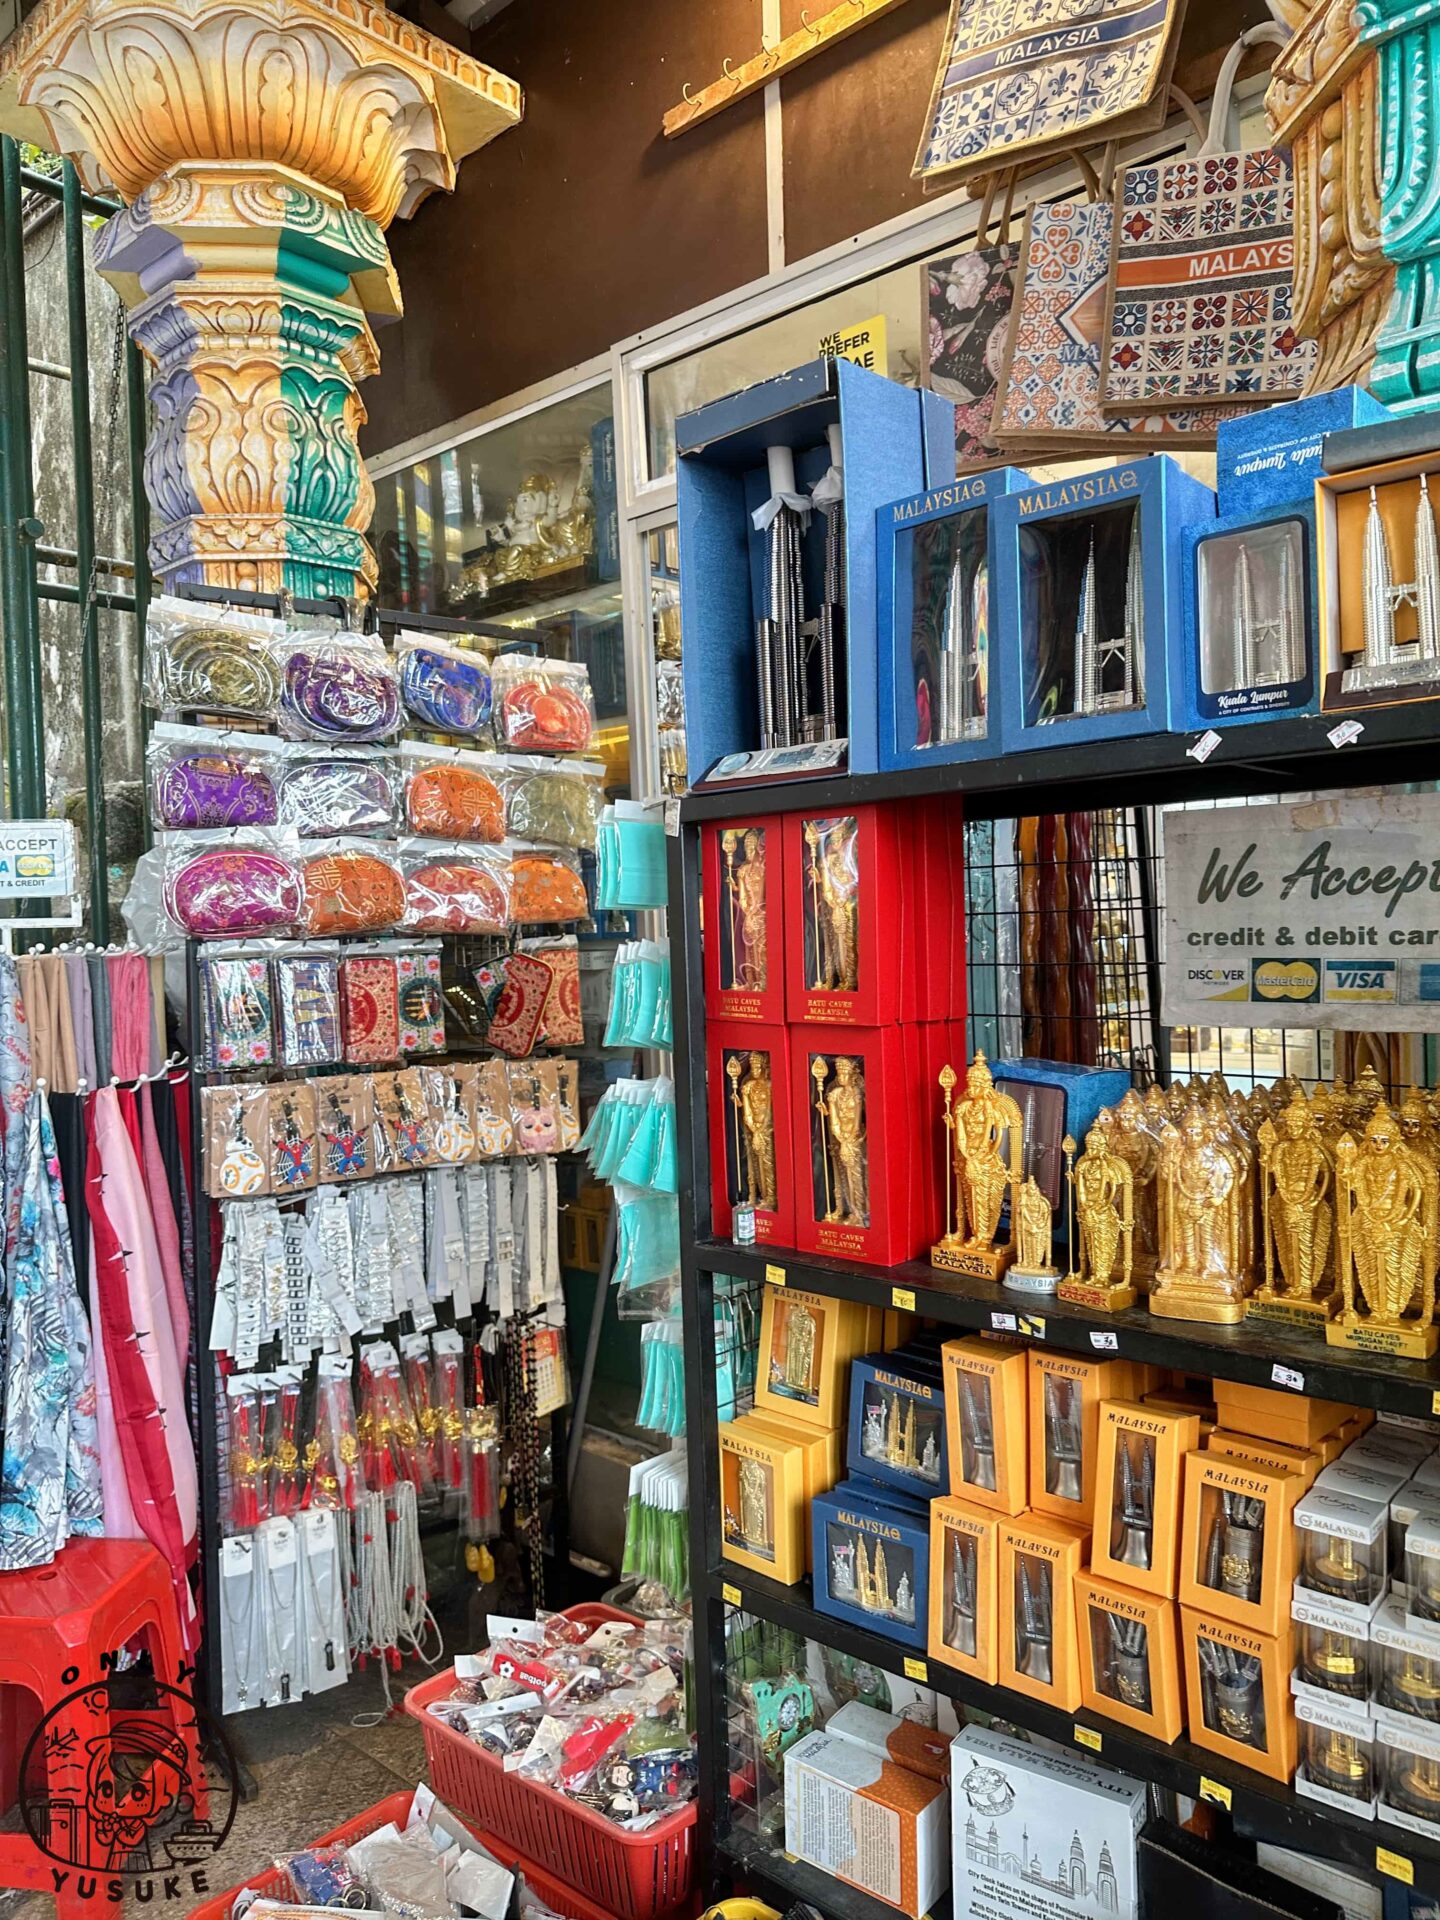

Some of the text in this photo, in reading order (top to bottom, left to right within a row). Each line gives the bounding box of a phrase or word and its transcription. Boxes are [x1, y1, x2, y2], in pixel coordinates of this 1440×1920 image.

[995, 27, 1100, 66] MALAYSIA
[1189, 243, 1293, 277] MALAYS
[819, 332, 870, 357] PREFER
[820, 332, 841, 348] WE
[1290, 444, 1322, 465] uala
[893, 485, 970, 523] MALAYSIA
[1019, 474, 1119, 517] MALAYSIA
[1218, 688, 1288, 708] Kuala Lumpur
[15, 879, 45, 887] CREDIT
[1198, 843, 1263, 904] We
[1187, 927, 1265, 946] credit
[1275, 927, 1295, 946] &
[1305, 926, 1378, 945] debit
[1188, 970, 1244, 980] DISCOVER
[1256, 974, 1315, 987] MasterCard
[1335, 972, 1386, 989] VISA
[725, 1005, 758, 1013] MALAYSIA
[810, 1007, 849, 1016] MALAYSIA
[821, 1238, 861, 1250] MALAYSIA
[839, 1232, 864, 1243] CAVES
[933, 1257, 993, 1277] MALAYSIA
[1008, 1274, 1056, 1289] MALAYSIA
[773, 1286, 822, 1306] MALAYSIA
[1375, 1330, 1401, 1342] CAVES
[947, 1355, 995, 1375] MALAYSIA
[1036, 1358, 1088, 1378] MALAYSIA
[874, 1369, 923, 1394] MALAYSIA
[1107, 1411, 1167, 1435] MALAYSIA
[723, 1437, 772, 1463] MALAYSIA
[1204, 1468, 1269, 1494] MALAYSIA
[837, 1510, 890, 1538] MALAYSIA
[936, 1510, 985, 1535] MALAYSIA
[1314, 1519, 1366, 1540] MALAYSIA
[1005, 1534, 1060, 1559] MALAYSIA
[1088, 1591, 1147, 1619] MALAYSIA
[1310, 1613, 1362, 1636] MALAYSIA
[1198, 1622, 1262, 1652] MALAYSIA
[965, 1734, 1038, 1765] MALAYSIA
[1096, 1781, 1133, 1798] CITY
[968, 1869, 980, 1880] City
[980, 1874, 996, 1884] Clock
[1021, 1887, 1030, 1898] the
[971, 1901, 985, 1911] With
[973, 1886, 997, 1901] Petronas
[997, 1895, 1011, 1906] Twin
[1011, 1901, 1030, 1914] Towers
[984, 1883, 994, 1891] and
[1019, 1896, 1049, 1913] Malaysian
